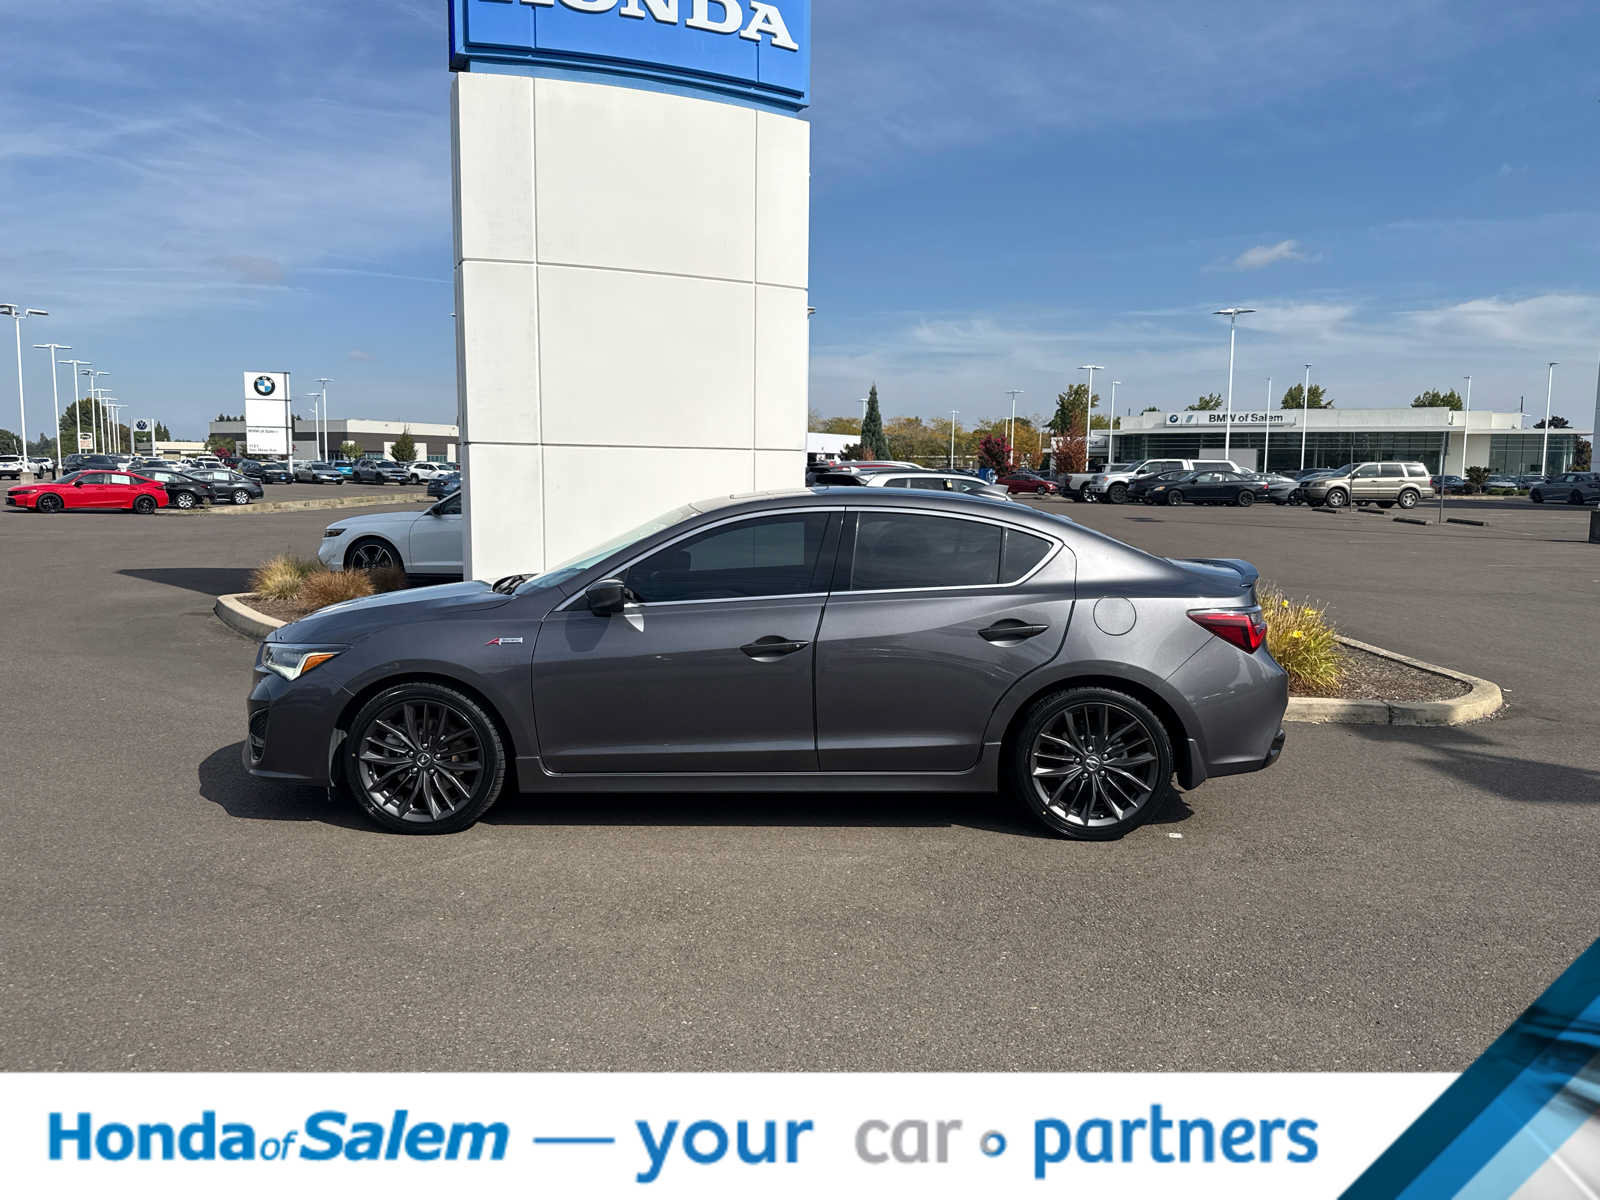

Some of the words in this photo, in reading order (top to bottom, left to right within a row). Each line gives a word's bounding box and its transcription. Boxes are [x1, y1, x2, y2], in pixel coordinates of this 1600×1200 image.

[479, 0, 799, 50] NDA
[1238, 413, 1249, 423] of
[1250, 413, 1283, 423] Salem
